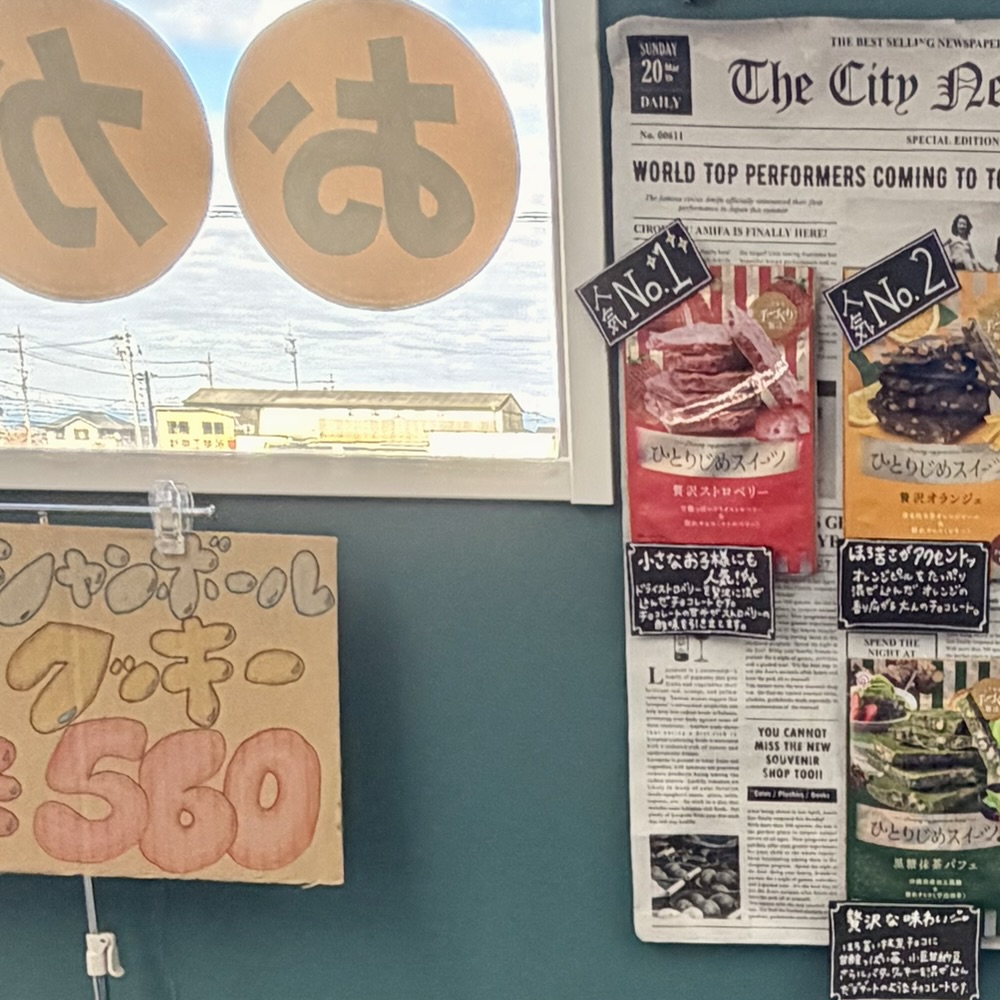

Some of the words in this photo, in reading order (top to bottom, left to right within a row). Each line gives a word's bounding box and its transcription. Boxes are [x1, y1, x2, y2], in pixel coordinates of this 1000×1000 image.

[639, 42, 677, 57] SUNDAY
[856, 36, 883, 48] BEST
[641, 58, 663, 84] 20
[728, 58, 814, 114] The
[829, 60, 918, 116] City
[640, 96, 682, 110] DAILY
[906, 135, 950, 146] SPECIAL
[954, 136, 1000, 146] EDITION
[632, 160, 696, 184] WORLD
[704, 162, 739, 185] TOP
[745, 164, 866, 188] PERFORMERS
[873, 165, 948, 189] COMING
[955, 167, 977, 190] TO
[696, 227, 730, 237] AMIFA
[733, 228, 743, 237] IS
[746, 228, 792, 238] FINALLY
[593, 284, 628, 336] 人気
[612, 241, 694, 321] No.1
[842, 289, 875, 345] 人気
[863, 247, 947, 329] No.2
[651, 446, 787, 472] ひとりじめスイーツ
[638, 549, 758, 572] 小さなお子様にも
[864, 638, 897, 648] SPEND
[899, 639, 920, 648] THE
[5, 615, 305, 734] クッキー
[758, 727, 781, 738] YOU
[783, 727, 827, 739] CANNOT
[754, 740, 781, 752] MISS
[784, 741, 803, 752] THE
[806, 742, 831, 752] NEW
[765, 754, 820, 766] SOUVENIR
[762, 768, 790, 779] SHOP
[870, 821, 1000, 846] ひとりじめスイーツ
[846, 907, 948, 934] 贅沢な味わい
